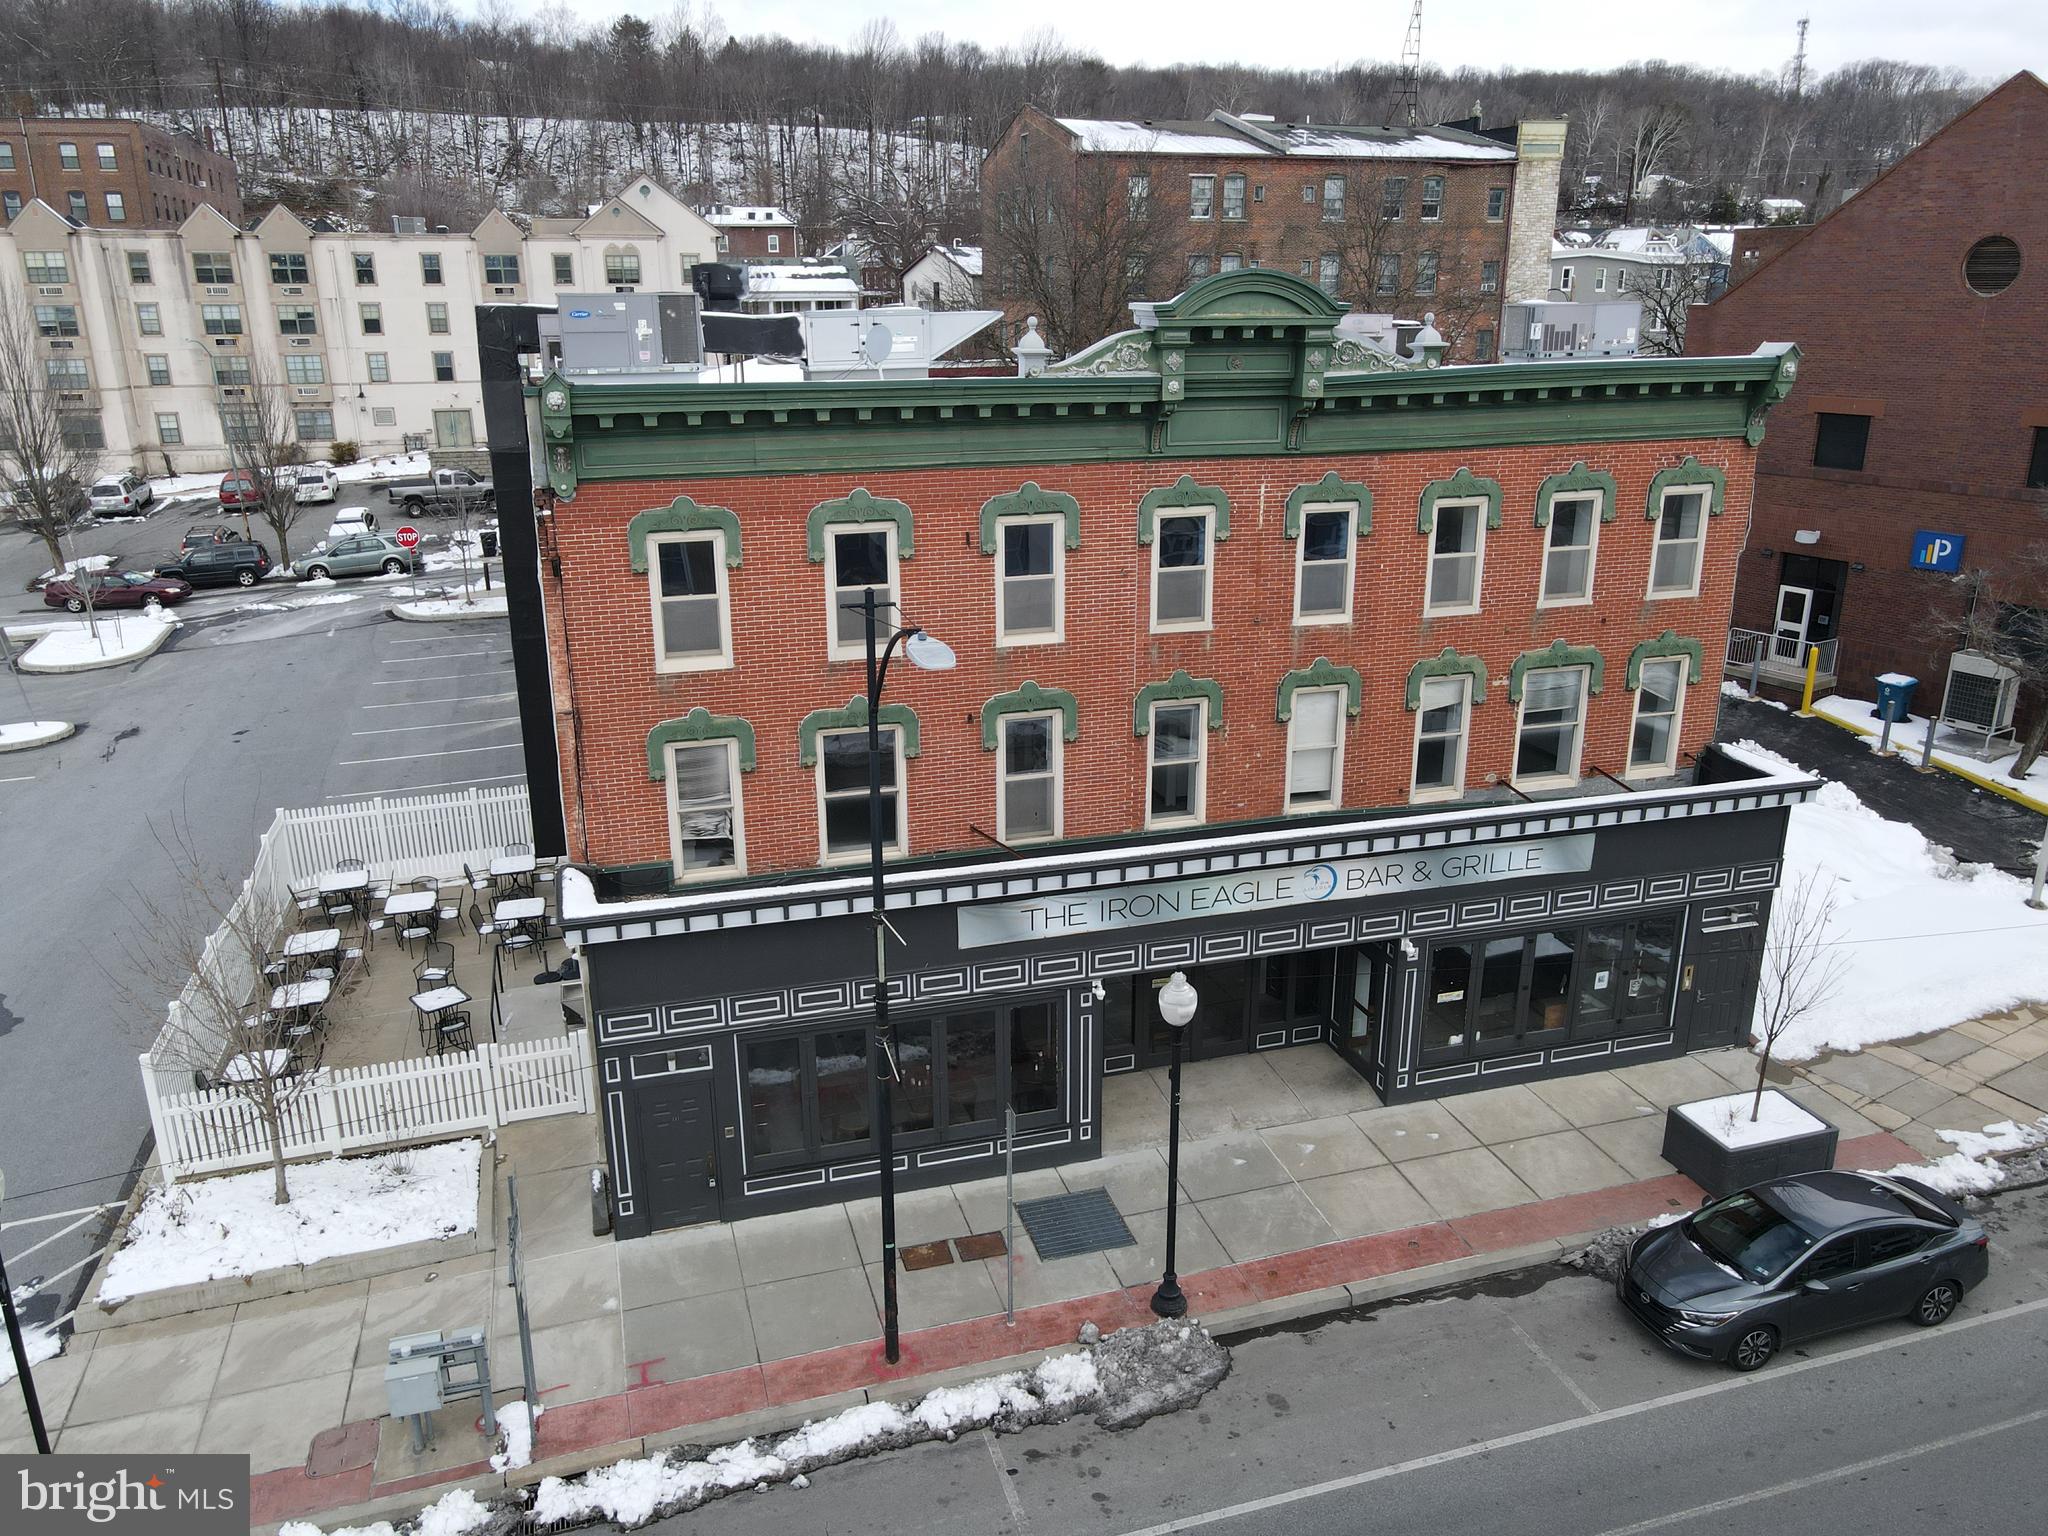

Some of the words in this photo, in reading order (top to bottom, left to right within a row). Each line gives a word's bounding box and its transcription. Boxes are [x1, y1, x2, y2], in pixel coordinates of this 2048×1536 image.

[398, 533, 418, 541] STOP
[1020, 902, 1088, 931] THE
[1100, 890, 1180, 922] IRON
[1191, 881, 1294, 910] EAGLE
[1346, 864, 1404, 891] BAR
[1412, 860, 1432, 883] &
[1441, 847, 1544, 879] GRILLE
